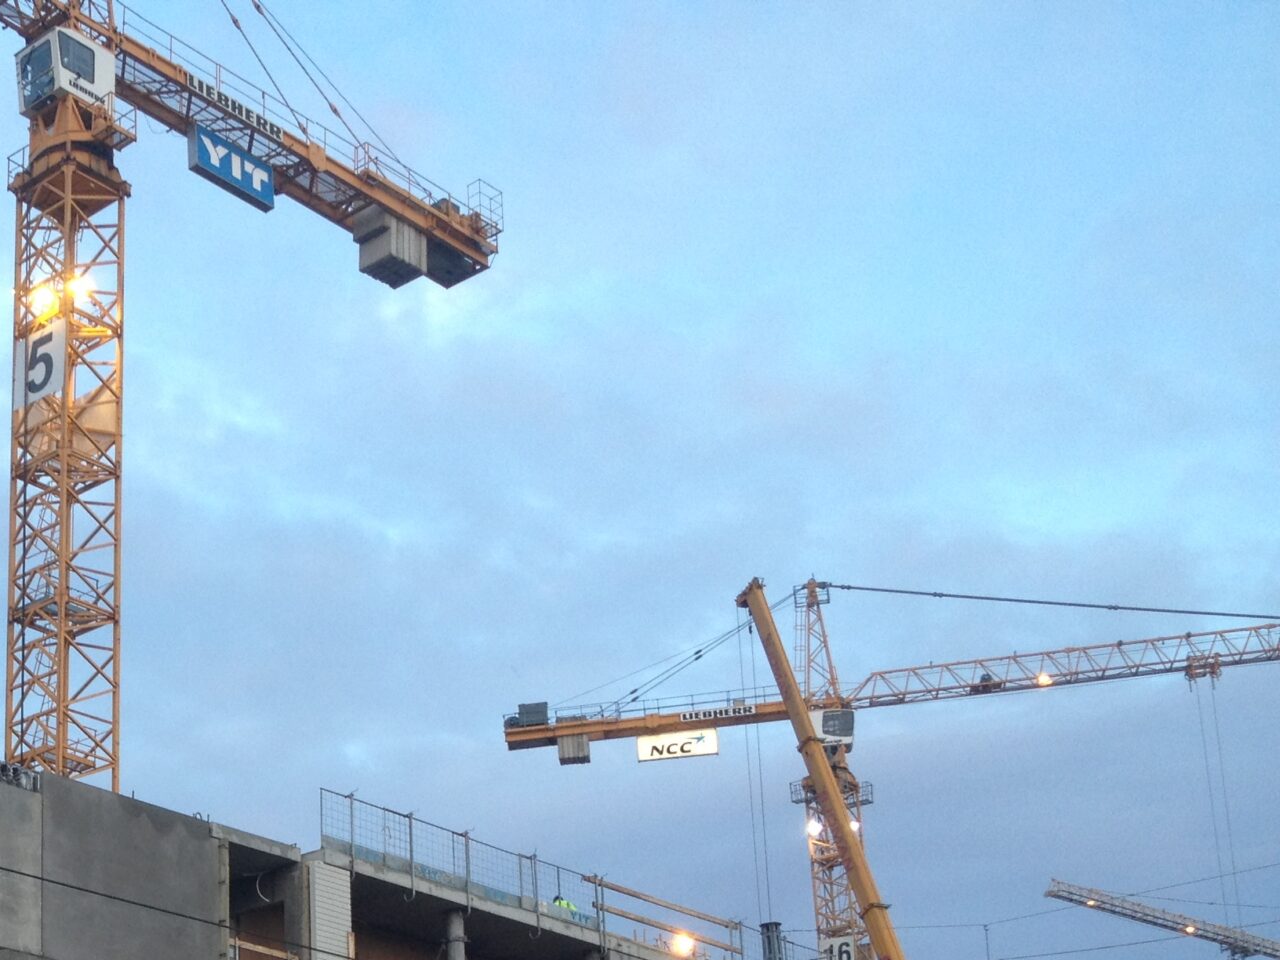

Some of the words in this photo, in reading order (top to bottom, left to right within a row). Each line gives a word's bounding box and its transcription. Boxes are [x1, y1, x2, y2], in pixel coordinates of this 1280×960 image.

[188, 75, 283, 140] LIEBHERR
[200, 135, 269, 192] YIT
[28, 332, 54, 394] 5
[682, 706, 753, 721] LIEBHERR
[650, 742, 693, 757] NCC
